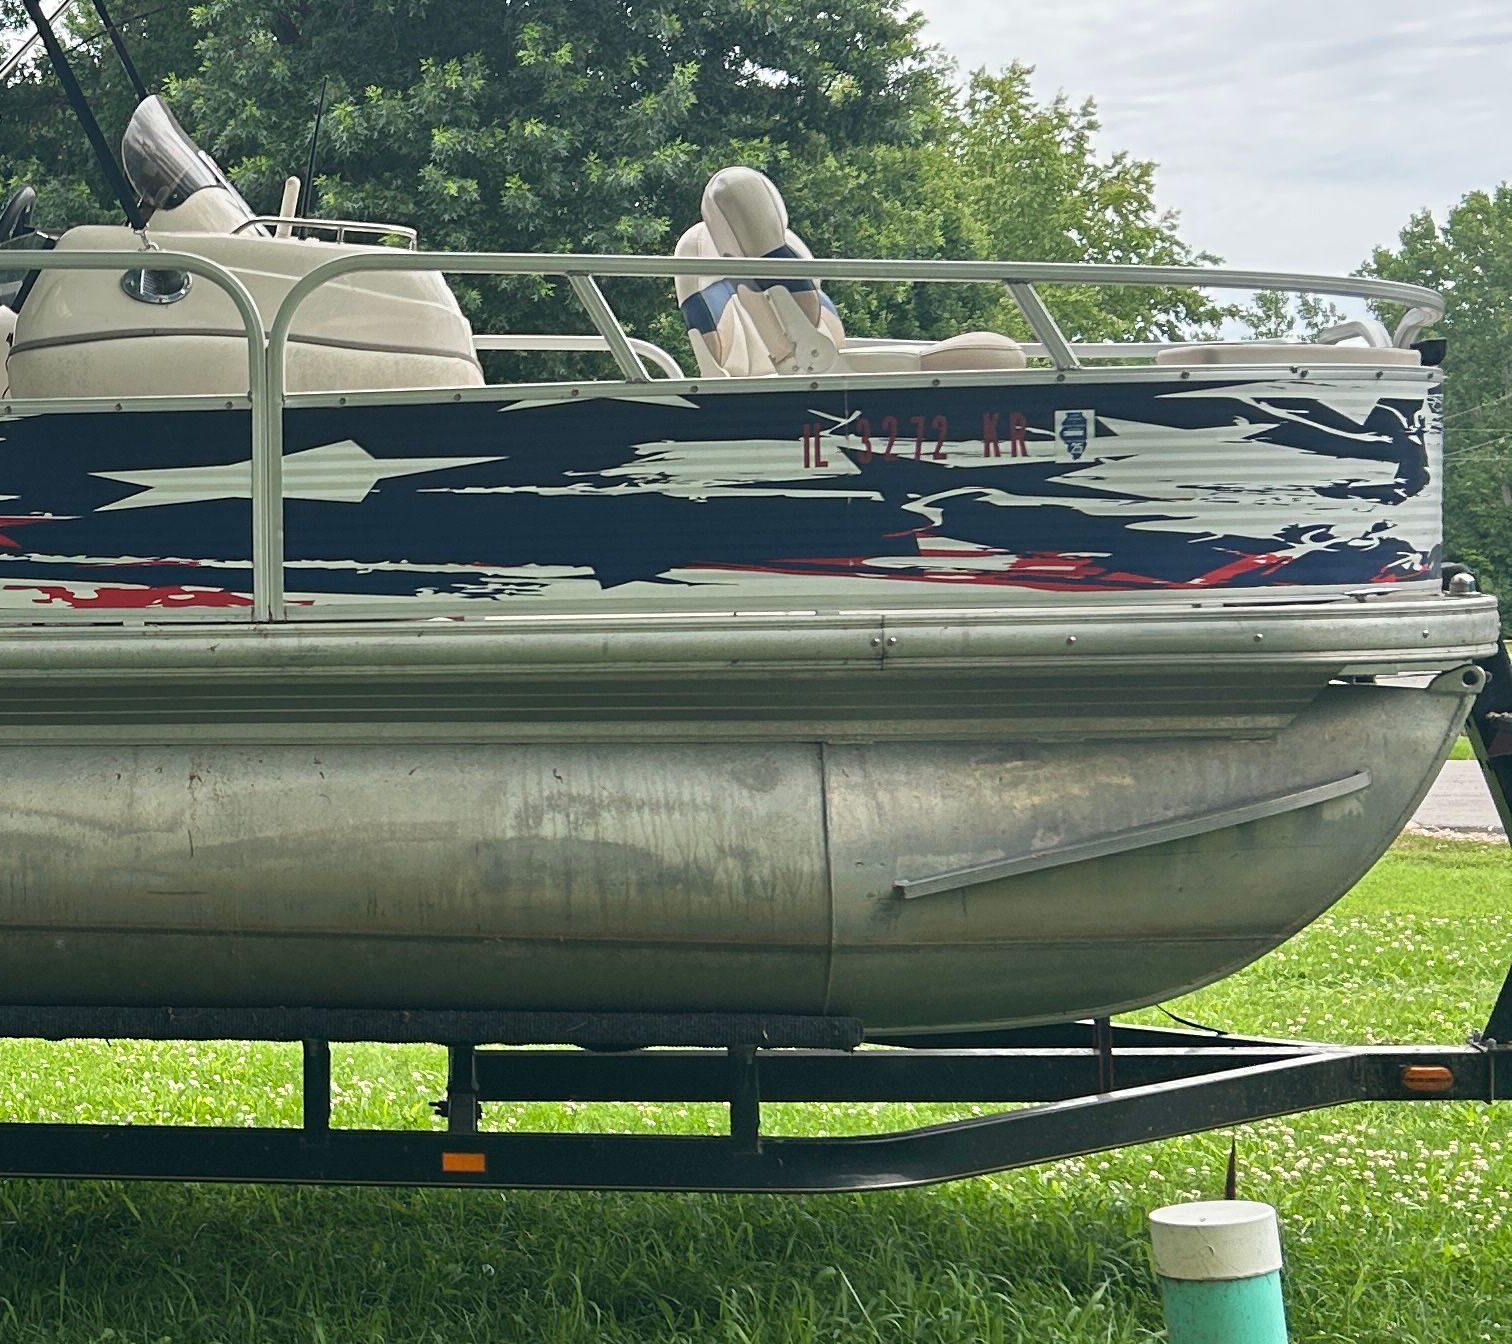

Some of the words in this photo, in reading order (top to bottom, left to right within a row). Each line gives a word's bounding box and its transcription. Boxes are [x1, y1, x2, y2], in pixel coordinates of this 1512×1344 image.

[803, 422, 829, 468] IL
[855, 414, 948, 465] 3272
[983, 412, 1028, 458] KR
